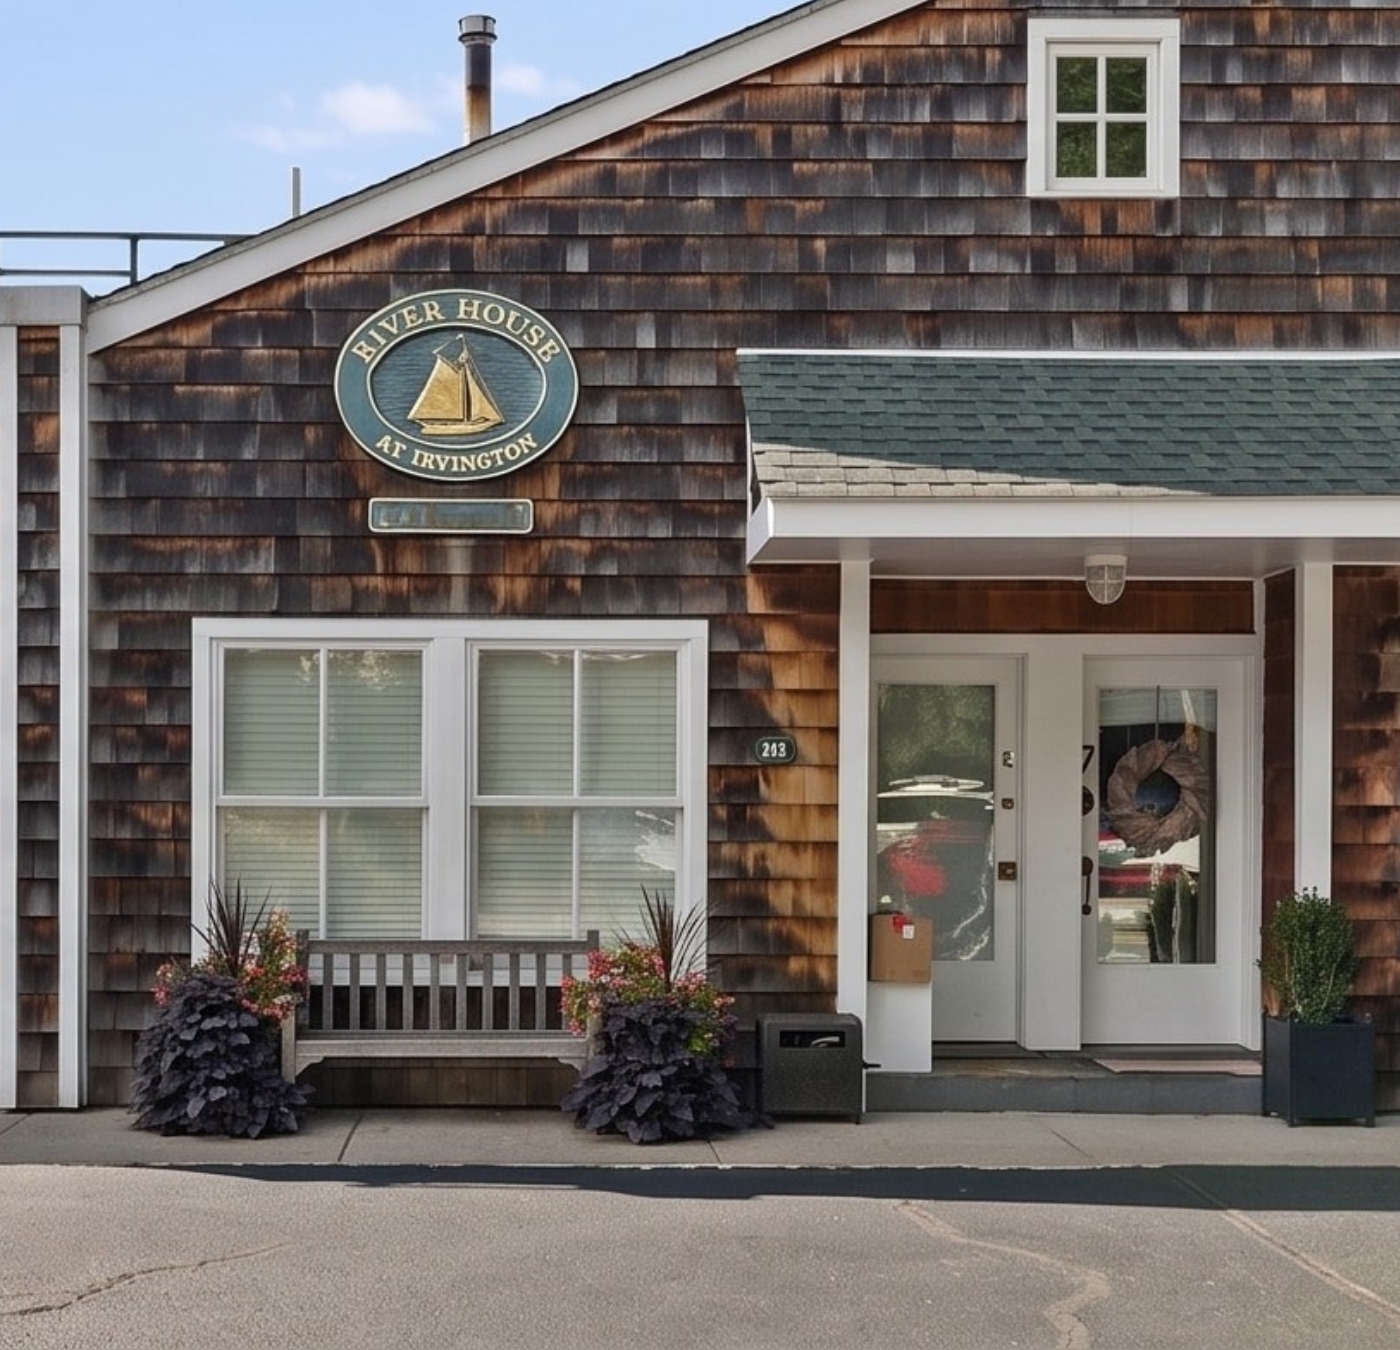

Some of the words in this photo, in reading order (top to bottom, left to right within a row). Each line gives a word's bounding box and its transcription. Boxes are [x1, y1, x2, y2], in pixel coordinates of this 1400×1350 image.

[351, 300, 446, 364] RIVER
[457, 298, 561, 364] HOUSE
[375, 434, 407, 459] AT
[411, 433, 538, 473] IRVINGTON
